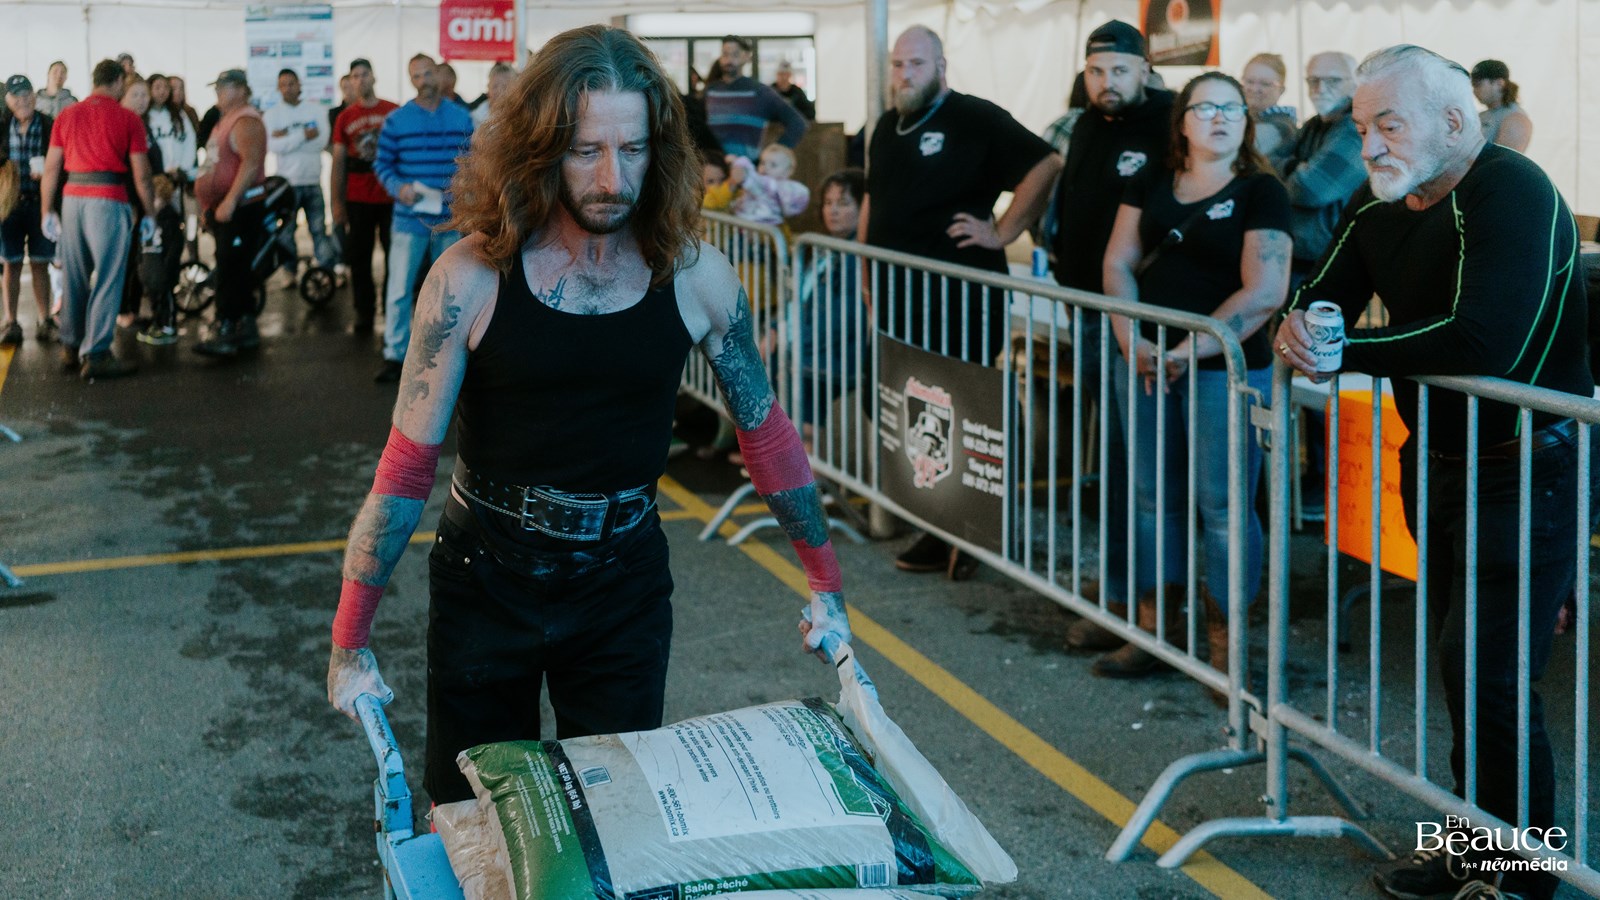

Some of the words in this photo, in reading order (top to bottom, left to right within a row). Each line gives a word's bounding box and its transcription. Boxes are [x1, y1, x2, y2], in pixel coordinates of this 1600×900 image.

[448, 9, 514, 42] ami
[558, 763, 568, 775] NET
[699, 769, 709, 782] winter
[706, 763, 718, 778] pavers
[565, 781, 573, 791] kg
[748, 778, 759, 793] l'hiver
[567, 789, 578, 800] (66
[755, 771, 767, 787] patios
[767, 795, 780, 819] trottoirs
[572, 799, 582, 810] lb)
[666, 784, 688, 835] 1-800-561-bomix
[659, 791, 679, 836] www.bomix.ca
[685, 882, 714, 894] Sable
[717, 878, 748, 890] séché
